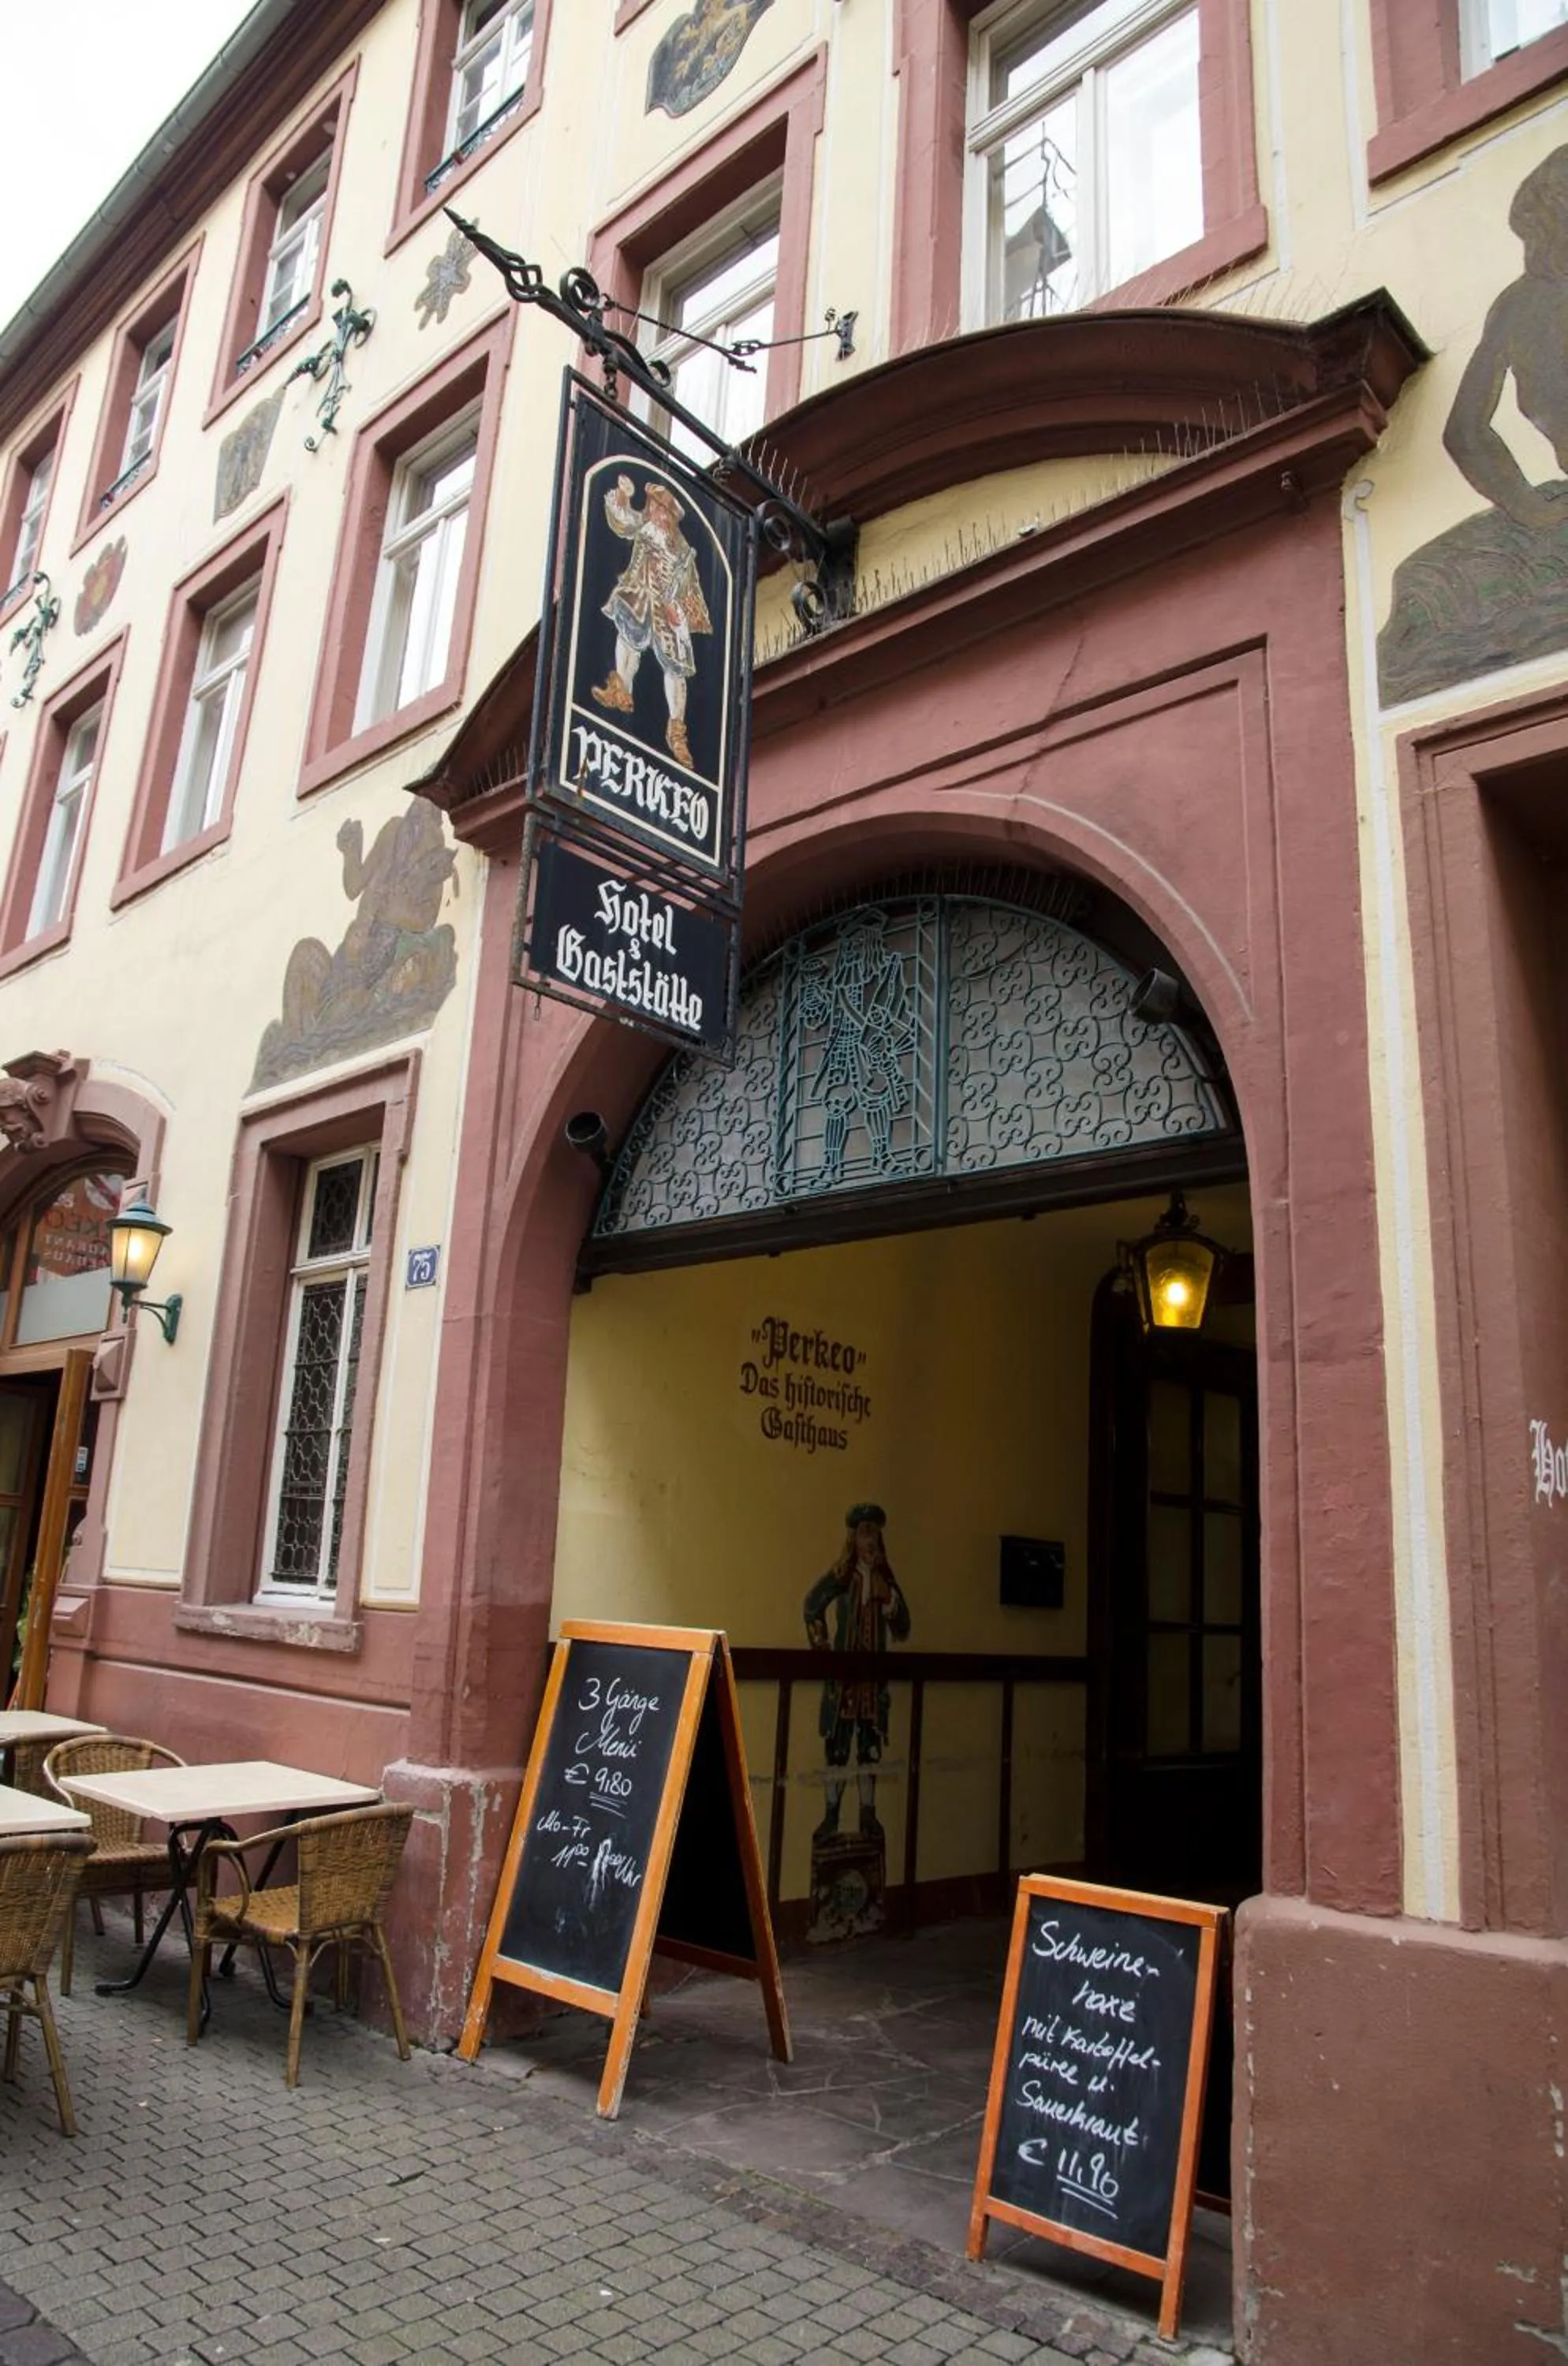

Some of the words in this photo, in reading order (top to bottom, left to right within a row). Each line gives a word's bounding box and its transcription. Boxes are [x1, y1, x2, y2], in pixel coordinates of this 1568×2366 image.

[572, 726, 709, 842] PERKEO
[594, 879, 677, 955] Hotel
[556, 924, 703, 1031] Gaststätte
[629, 938, 641, 960] &
[413, 1252, 433, 1282] 75
[739, 1361, 779, 1398] Das
[578, 1677, 600, 1711] 3
[599, 1677, 659, 1735] Gänge
[574, 1724, 641, 1759] Menü
[564, 1763, 590, 1785] €
[594, 1767, 633, 1797] 9,80
[1032, 1920, 1159, 1977] Schweine-
[1072, 1979, 1136, 2023] haxe
[1021, 2013, 1055, 2044] mit
[1061, 2025, 1162, 2071] Kartoffel-
[1018, 2051, 1080, 2086] püree
[1088, 2073, 1114, 2094] u.
[1015, 2080, 1140, 2147] Sauerkraut
[1017, 2138, 1047, 2166] €
[1058, 2147, 1119, 2200] 11,90
